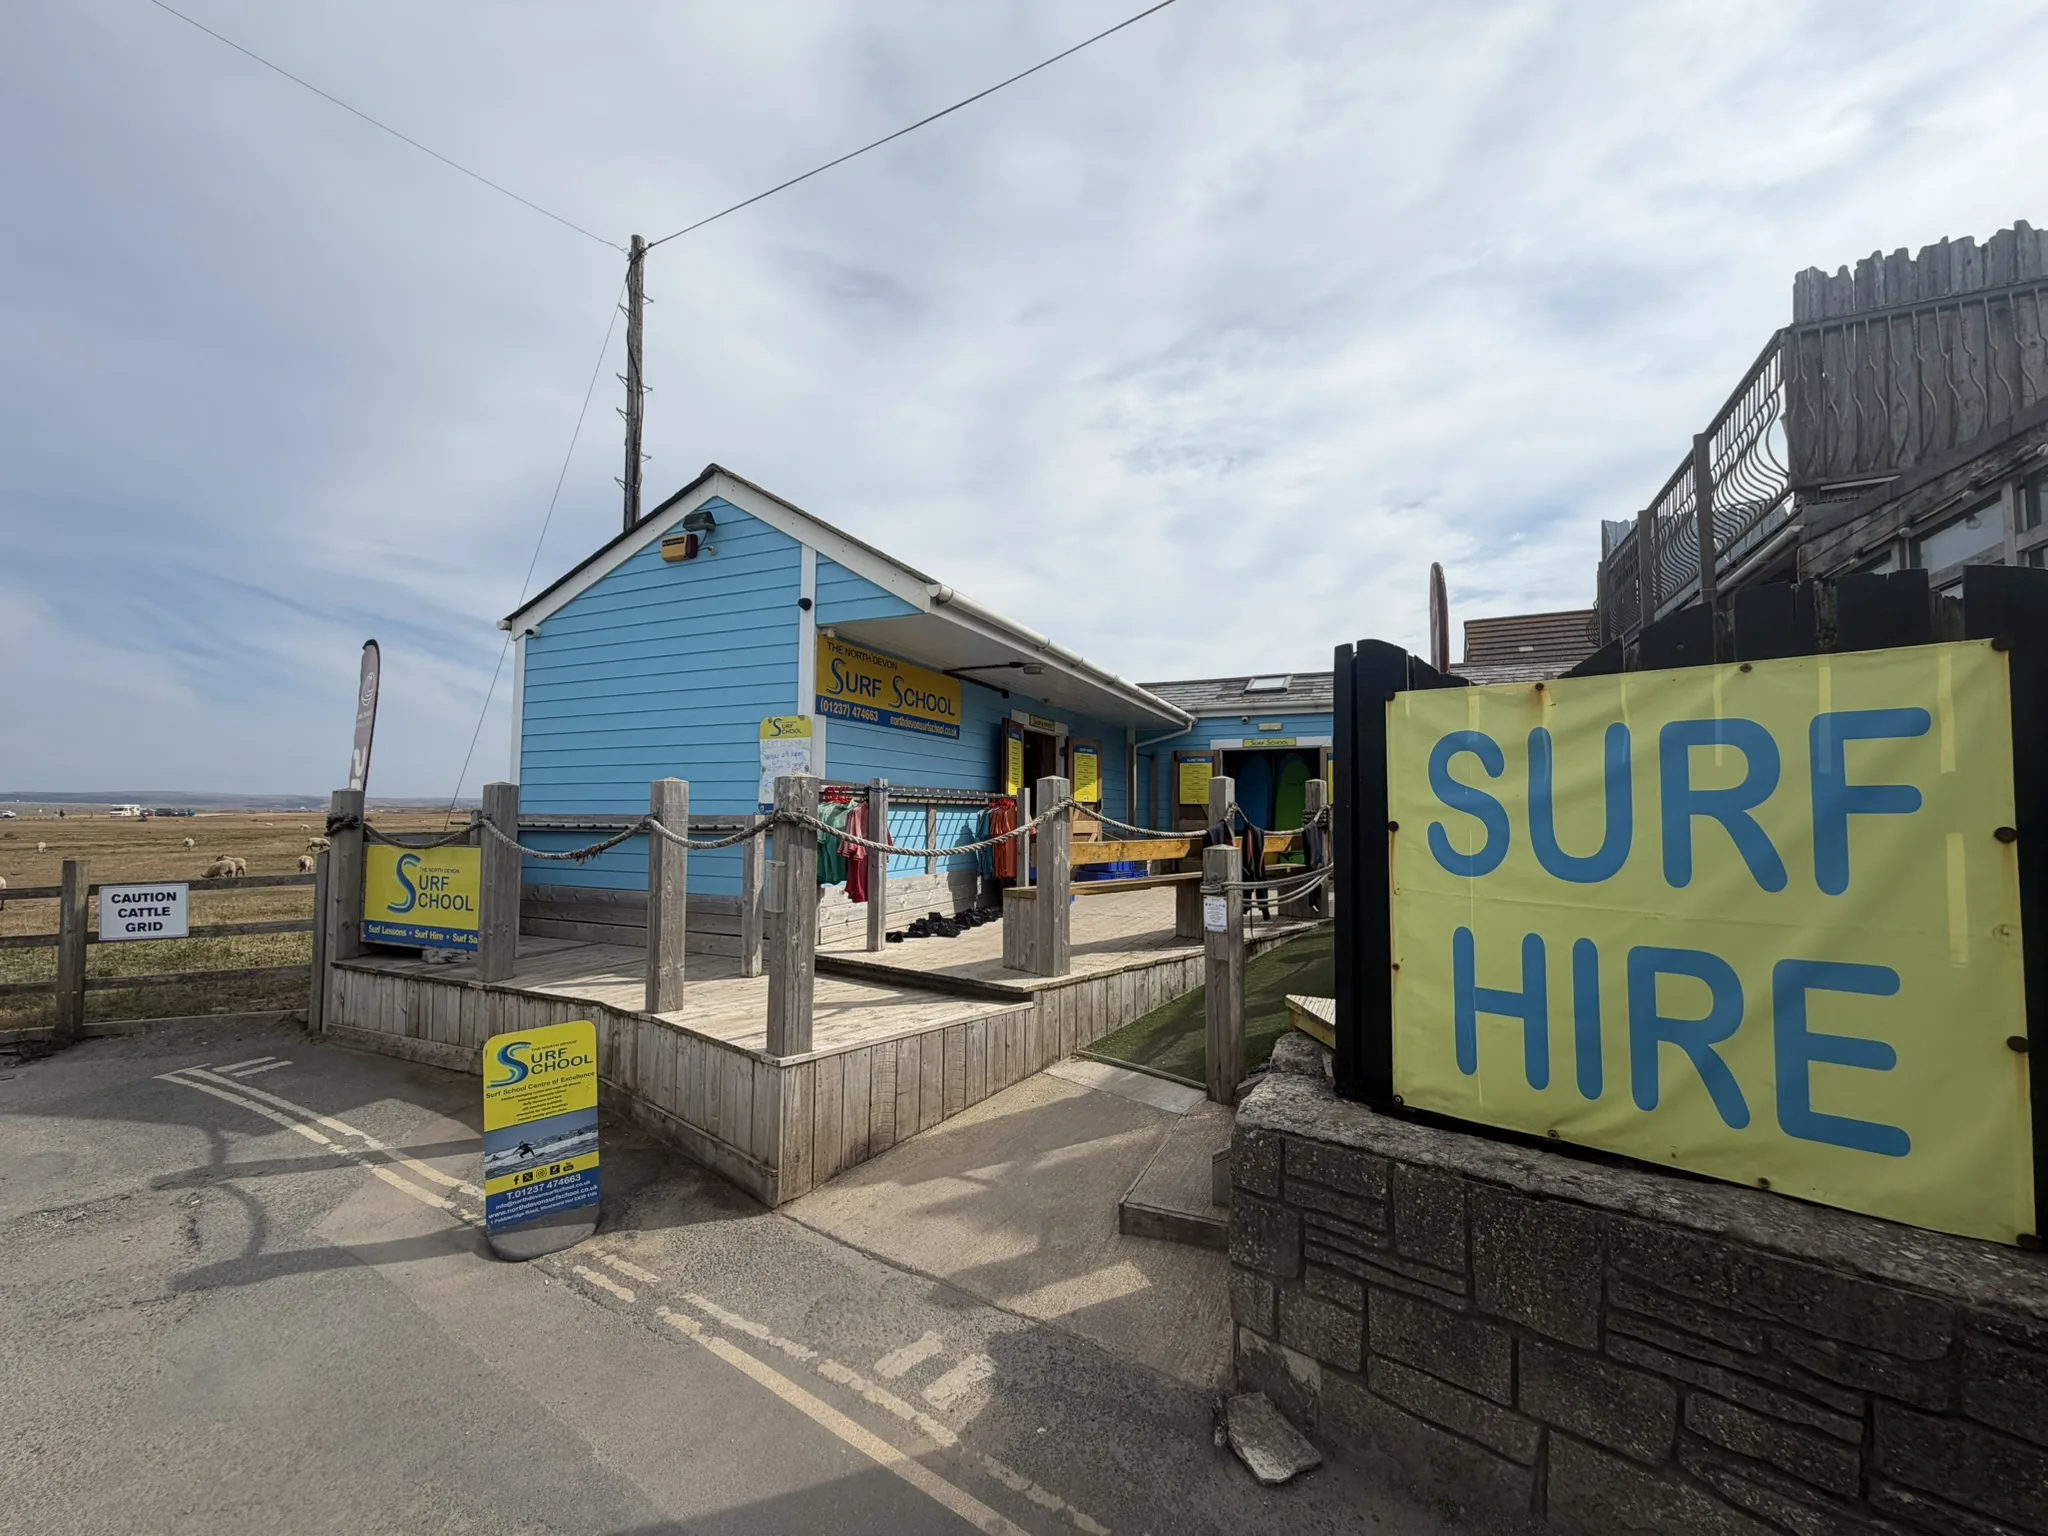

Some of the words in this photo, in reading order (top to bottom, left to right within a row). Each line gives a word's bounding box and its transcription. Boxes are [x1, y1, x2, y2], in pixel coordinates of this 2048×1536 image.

[827, 642, 844, 655] THE
[845, 649, 872, 663] NORTH
[872, 657, 898, 671] DEVON
[826, 657, 883, 698] SURF
[888, 675, 955, 716] SCHOOL
[820, 697, 850, 718] (01237)
[852, 706, 879, 722] 474663
[1427, 706, 1932, 896] SURF
[111, 892, 177, 904] CAUTION
[118, 906, 171, 918] CATTLE
[125, 921, 163, 932] GRID
[368, 924, 380, 933] Surf
[381, 925, 407, 936] Lessons
[414, 929, 427, 939] Surf
[429, 930, 443, 940] Hire
[452, 932, 466, 943] Surf
[1452, 926, 1912, 1158] HIRE
[486, 1090, 501, 1099] Surf
[503, 1084, 527, 1096] School
[528, 1080, 551, 1091] Centre
[552, 1077, 559, 1085] of
[560, 1071, 596, 1083] Excellence
[506, 1183, 545, 1201] T.01237
[546, 1173, 582, 1190] 474663
